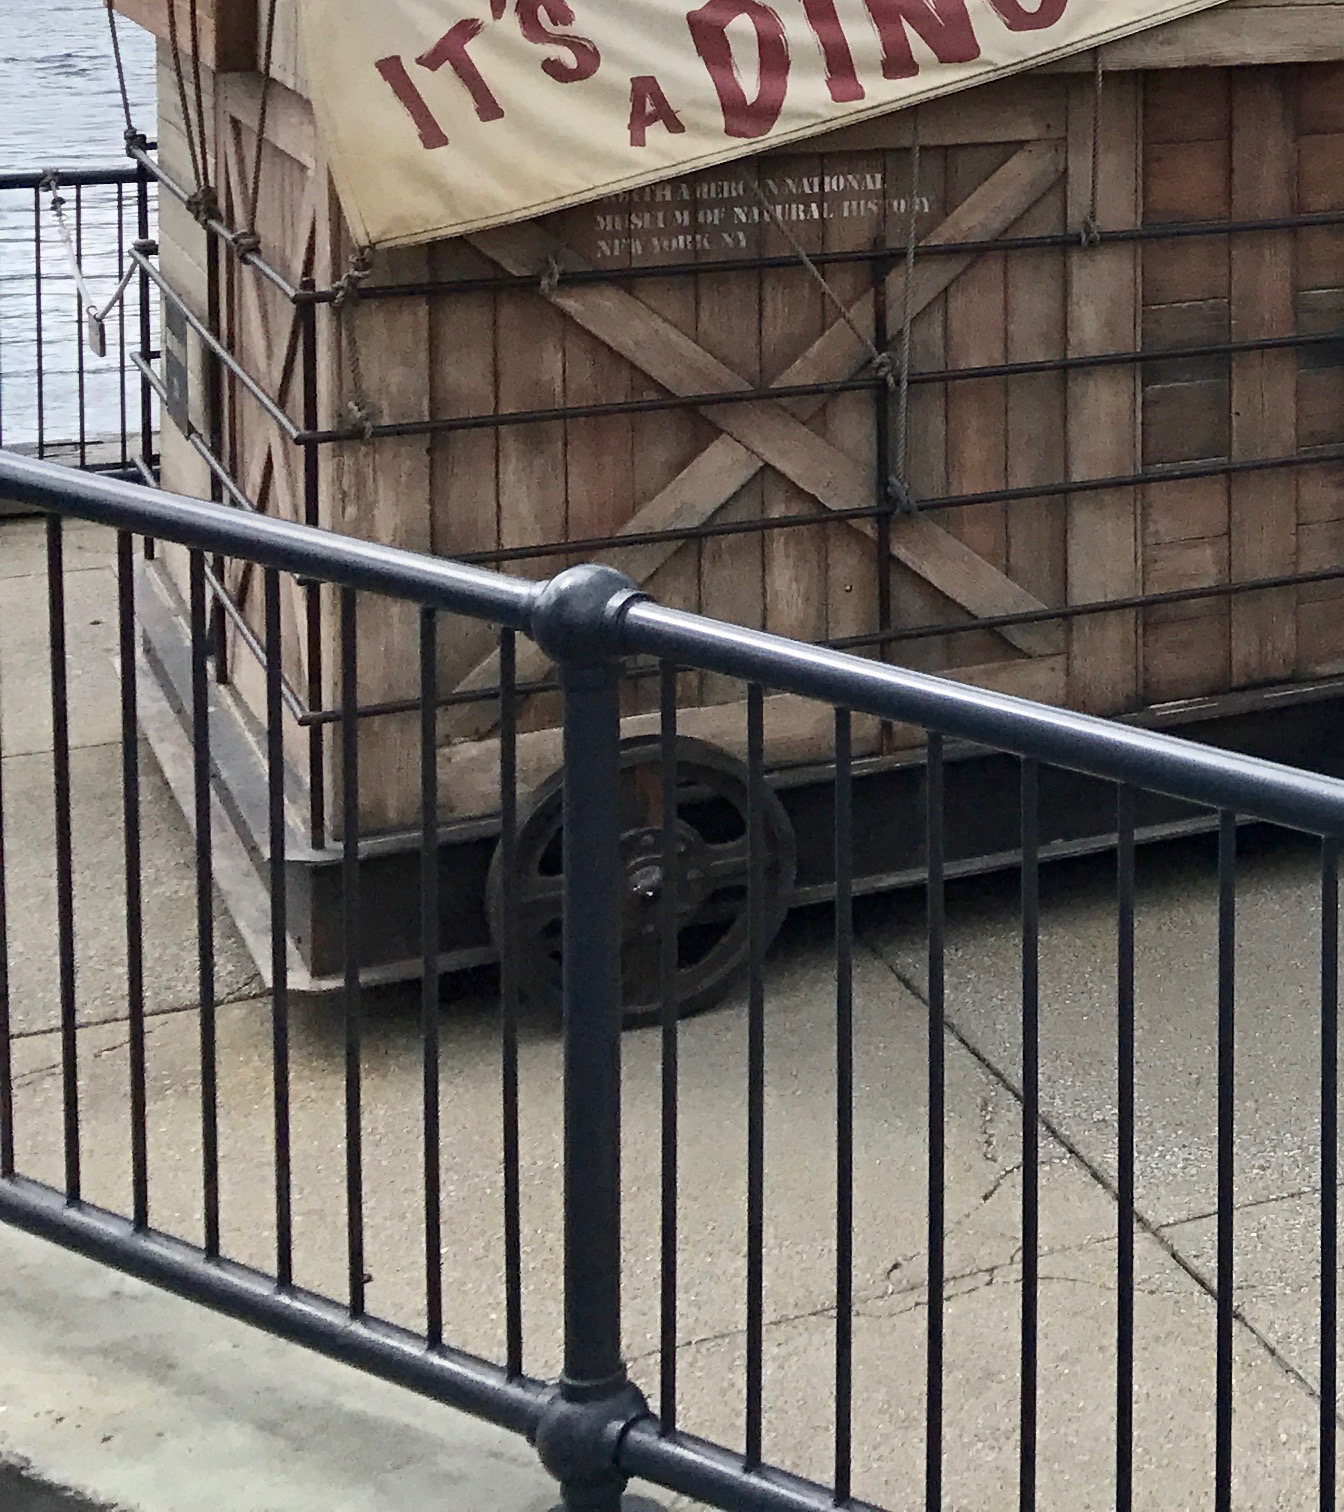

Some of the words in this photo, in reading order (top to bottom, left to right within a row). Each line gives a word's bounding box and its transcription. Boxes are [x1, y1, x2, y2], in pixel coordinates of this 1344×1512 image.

[626, 76, 685, 147] A
[784, 173, 888, 195] NATIONAL
[697, 206, 726, 226] OF
[597, 238, 643, 258] NEW
[720, 231, 747, 250] NY
